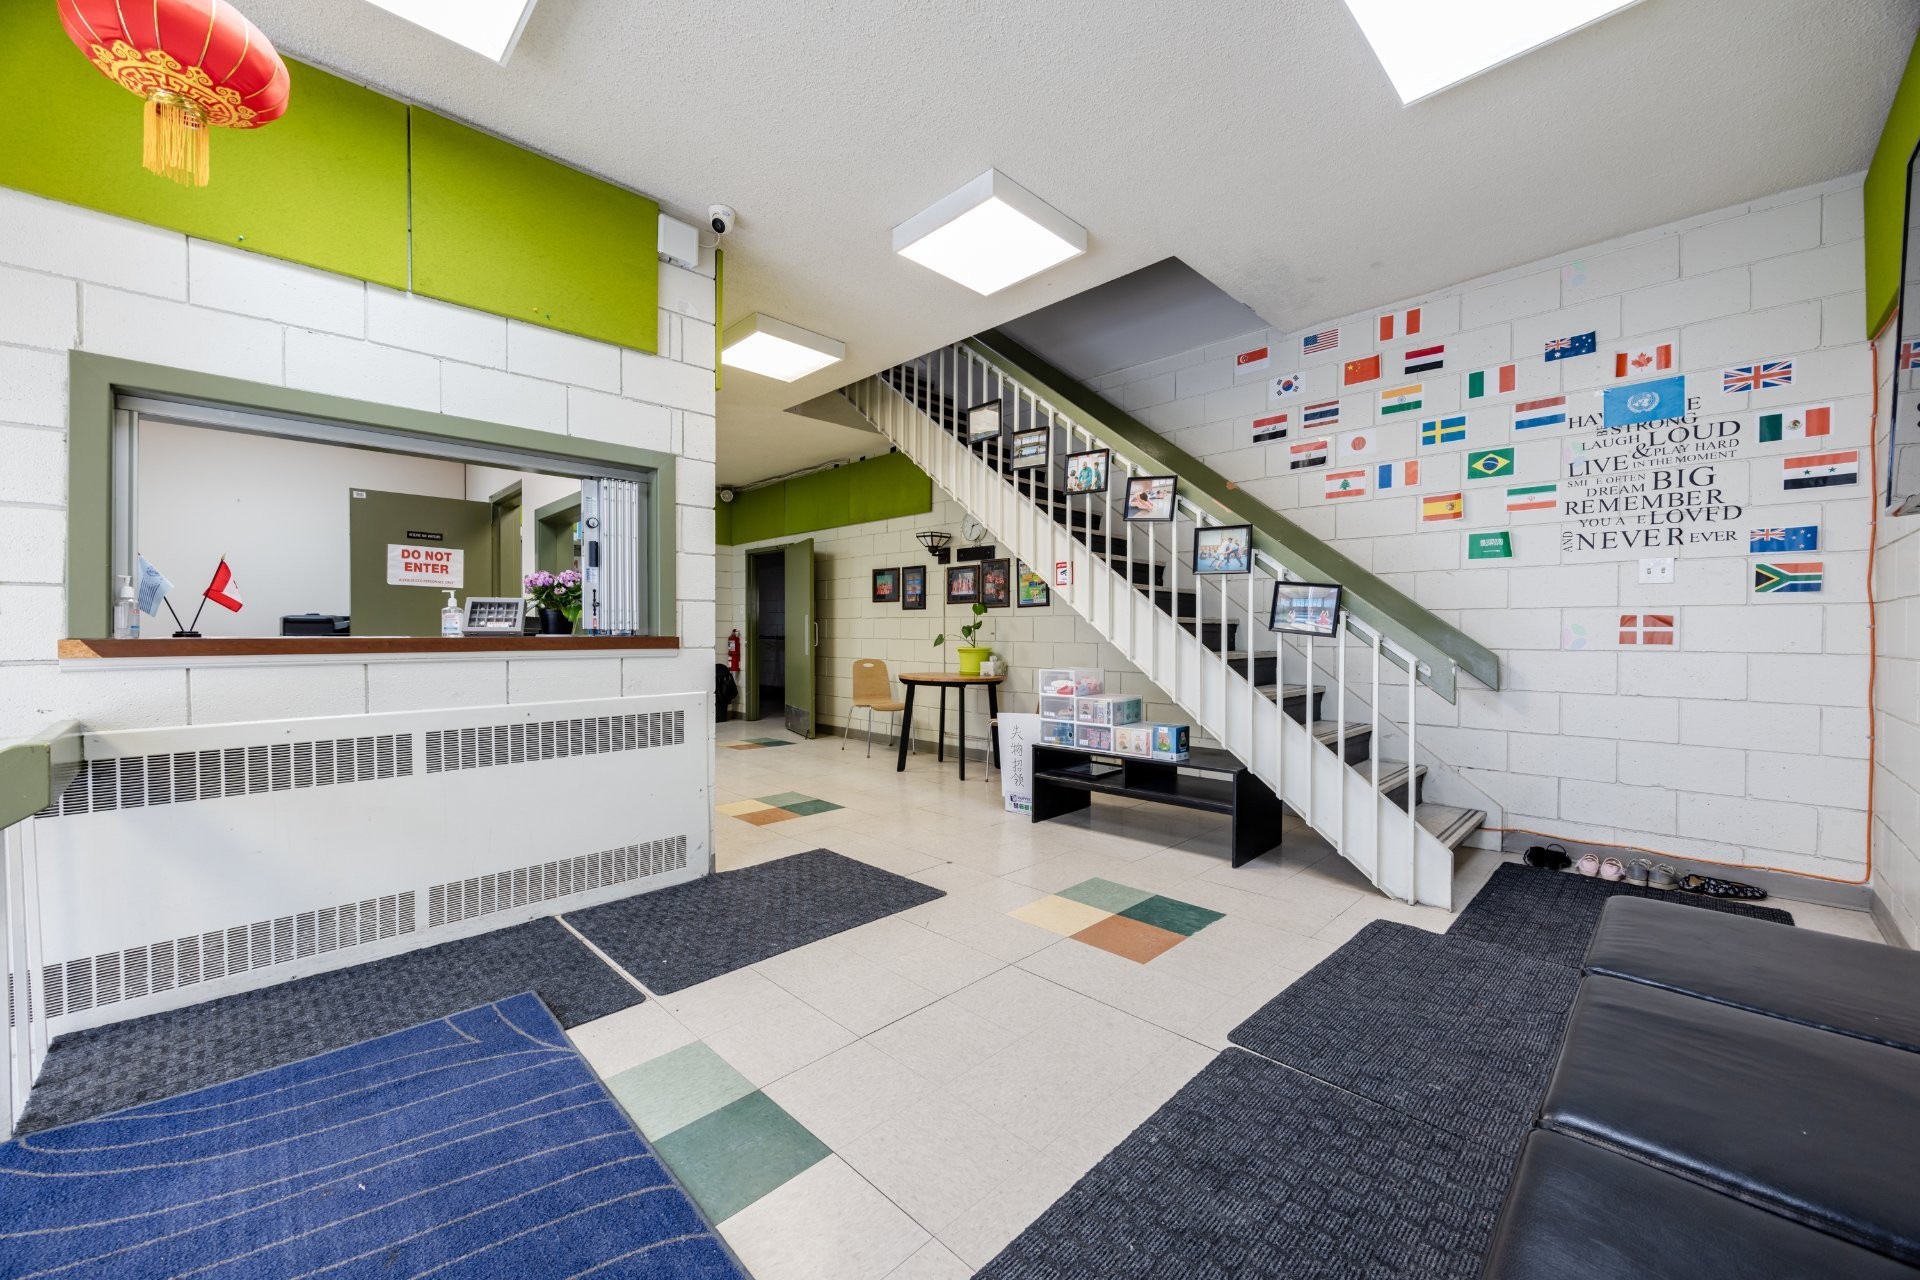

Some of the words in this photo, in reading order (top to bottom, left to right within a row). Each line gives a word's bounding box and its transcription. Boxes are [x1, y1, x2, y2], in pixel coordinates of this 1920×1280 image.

[1580, 433, 1640, 451] LAUGH
[1649, 420, 1741, 448] LOUD
[1632, 442, 1652, 459] &
[1654, 443, 1691, 456] PLAY
[1695, 438, 1739, 451] HARD
[1568, 453, 1628, 478] LIVE
[1633, 460, 1645, 469] IN
[1650, 457, 1673, 467] THE
[1675, 449, 1738, 463] MOMENT
[1586, 483, 1645, 497] DREAM
[1652, 465, 1717, 491] BIG
[1605, 473, 1646, 484] OFTEN
[1564, 488, 1725, 516] REMEMBER
[1578, 516, 1611, 528] YOU
[1562, 531, 1573, 553] AND
[1576, 527, 1684, 551] NEVER
[1690, 530, 1739, 543] EVER
[401, 549, 421, 560] DO
[425, 551, 452, 562] NOT
[404, 562, 449, 575] ENTER
